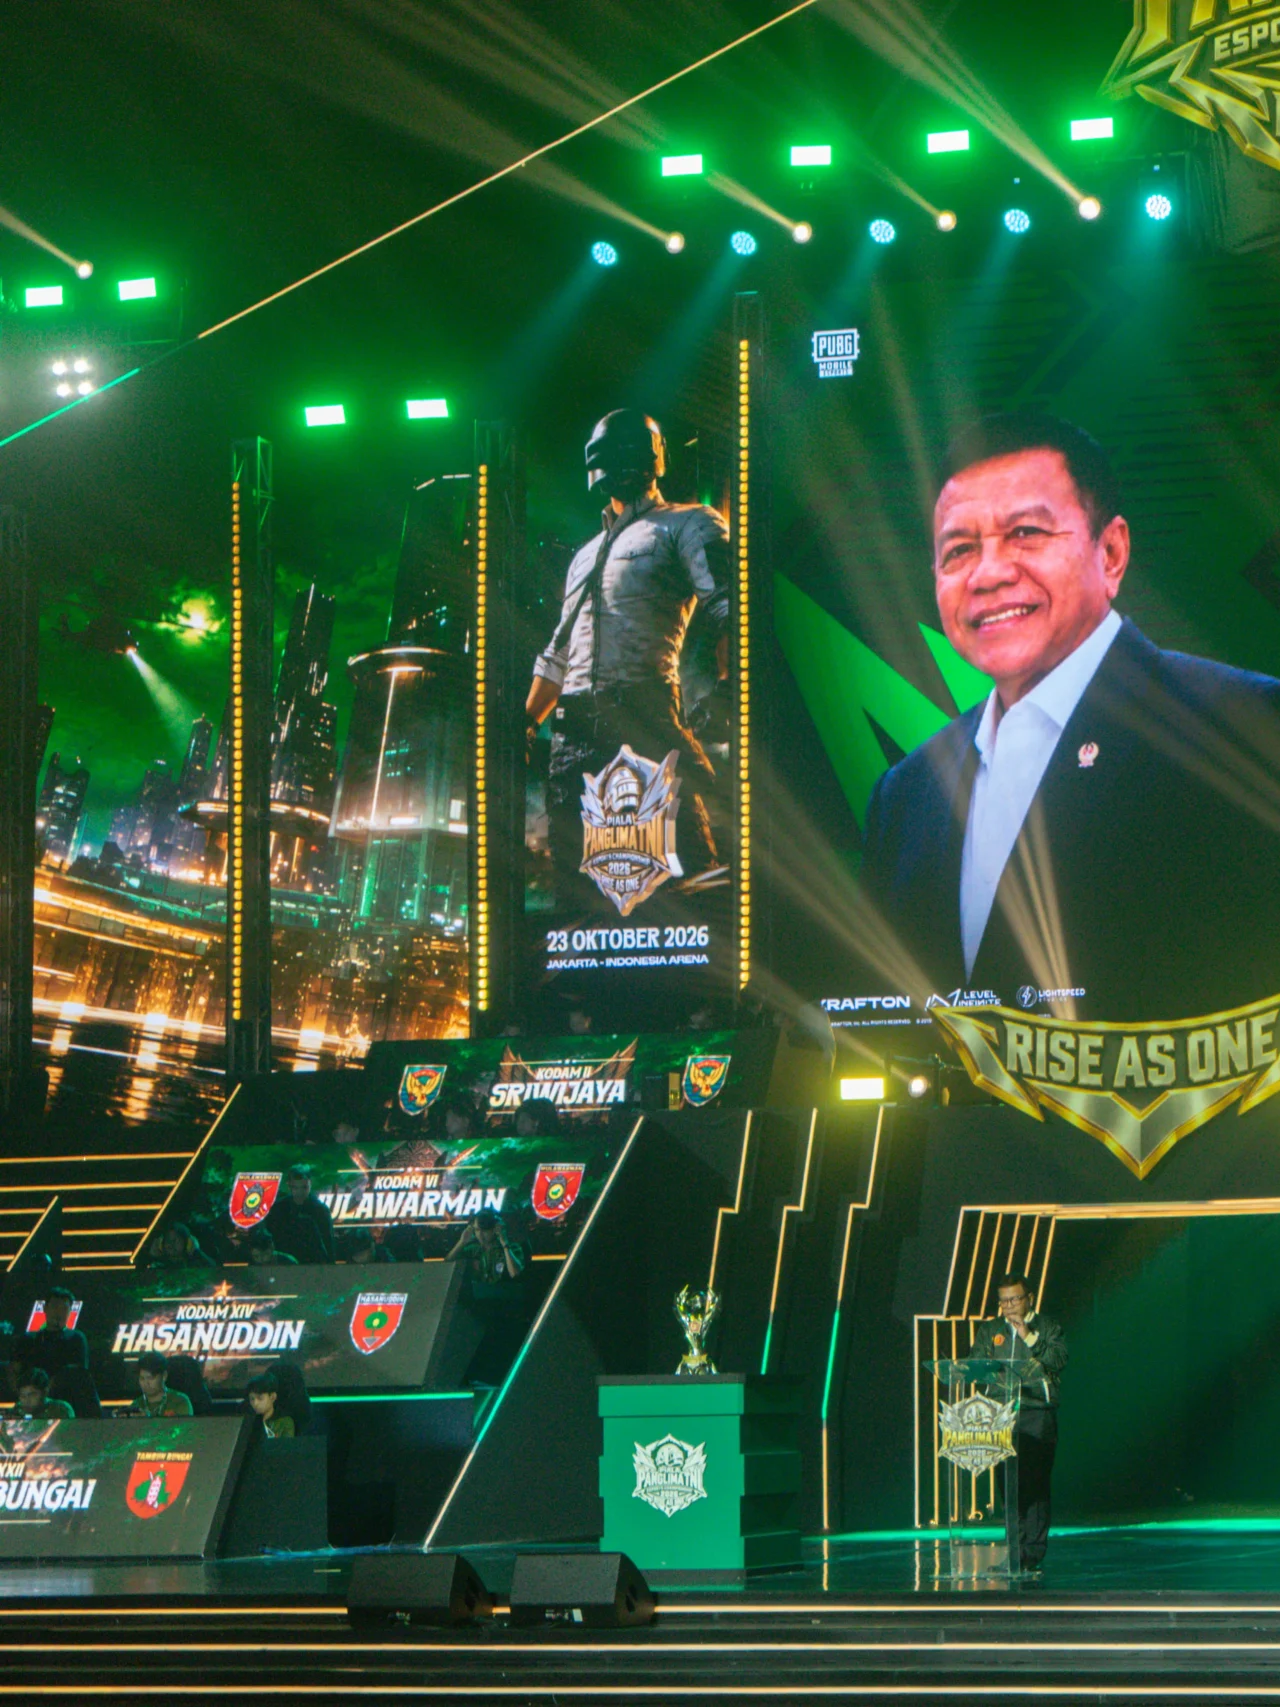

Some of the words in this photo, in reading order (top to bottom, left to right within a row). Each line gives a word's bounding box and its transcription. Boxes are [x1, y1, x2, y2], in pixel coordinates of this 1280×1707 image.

[818, 334, 853, 357] PUBG
[607, 814, 632, 827] PIALA
[583, 822, 638, 859] PANGLIMA
[608, 862, 630, 875] 2026
[547, 931, 568, 952] 23
[572, 928, 660, 950] OKTOBER
[664, 926, 708, 947] 2026
[546, 959, 598, 969] JAKARTA
[606, 956, 667, 967] INDONESIA
[669, 954, 709, 965] ARENA
[964, 990, 996, 999] LEVEL
[1038, 988, 1085, 998] LIGHTSPEED
[1003, 1020, 1104, 1086] RISE
[1113, 1036, 1176, 1088] AS
[1187, 1010, 1280, 1083] ONE
[535, 1066, 582, 1080] KODAM
[582, 1066, 593, 1078] II
[489, 1079, 626, 1107] SRIWIJAYA
[374, 1175, 424, 1190] KODAM
[426, 1174, 439, 1188] VI
[176, 1305, 229, 1320] KODAM
[230, 1304, 255, 1319] XIV
[112, 1320, 305, 1353] HASANUDDIN
[943, 1426, 992, 1449] PANGLIMA
